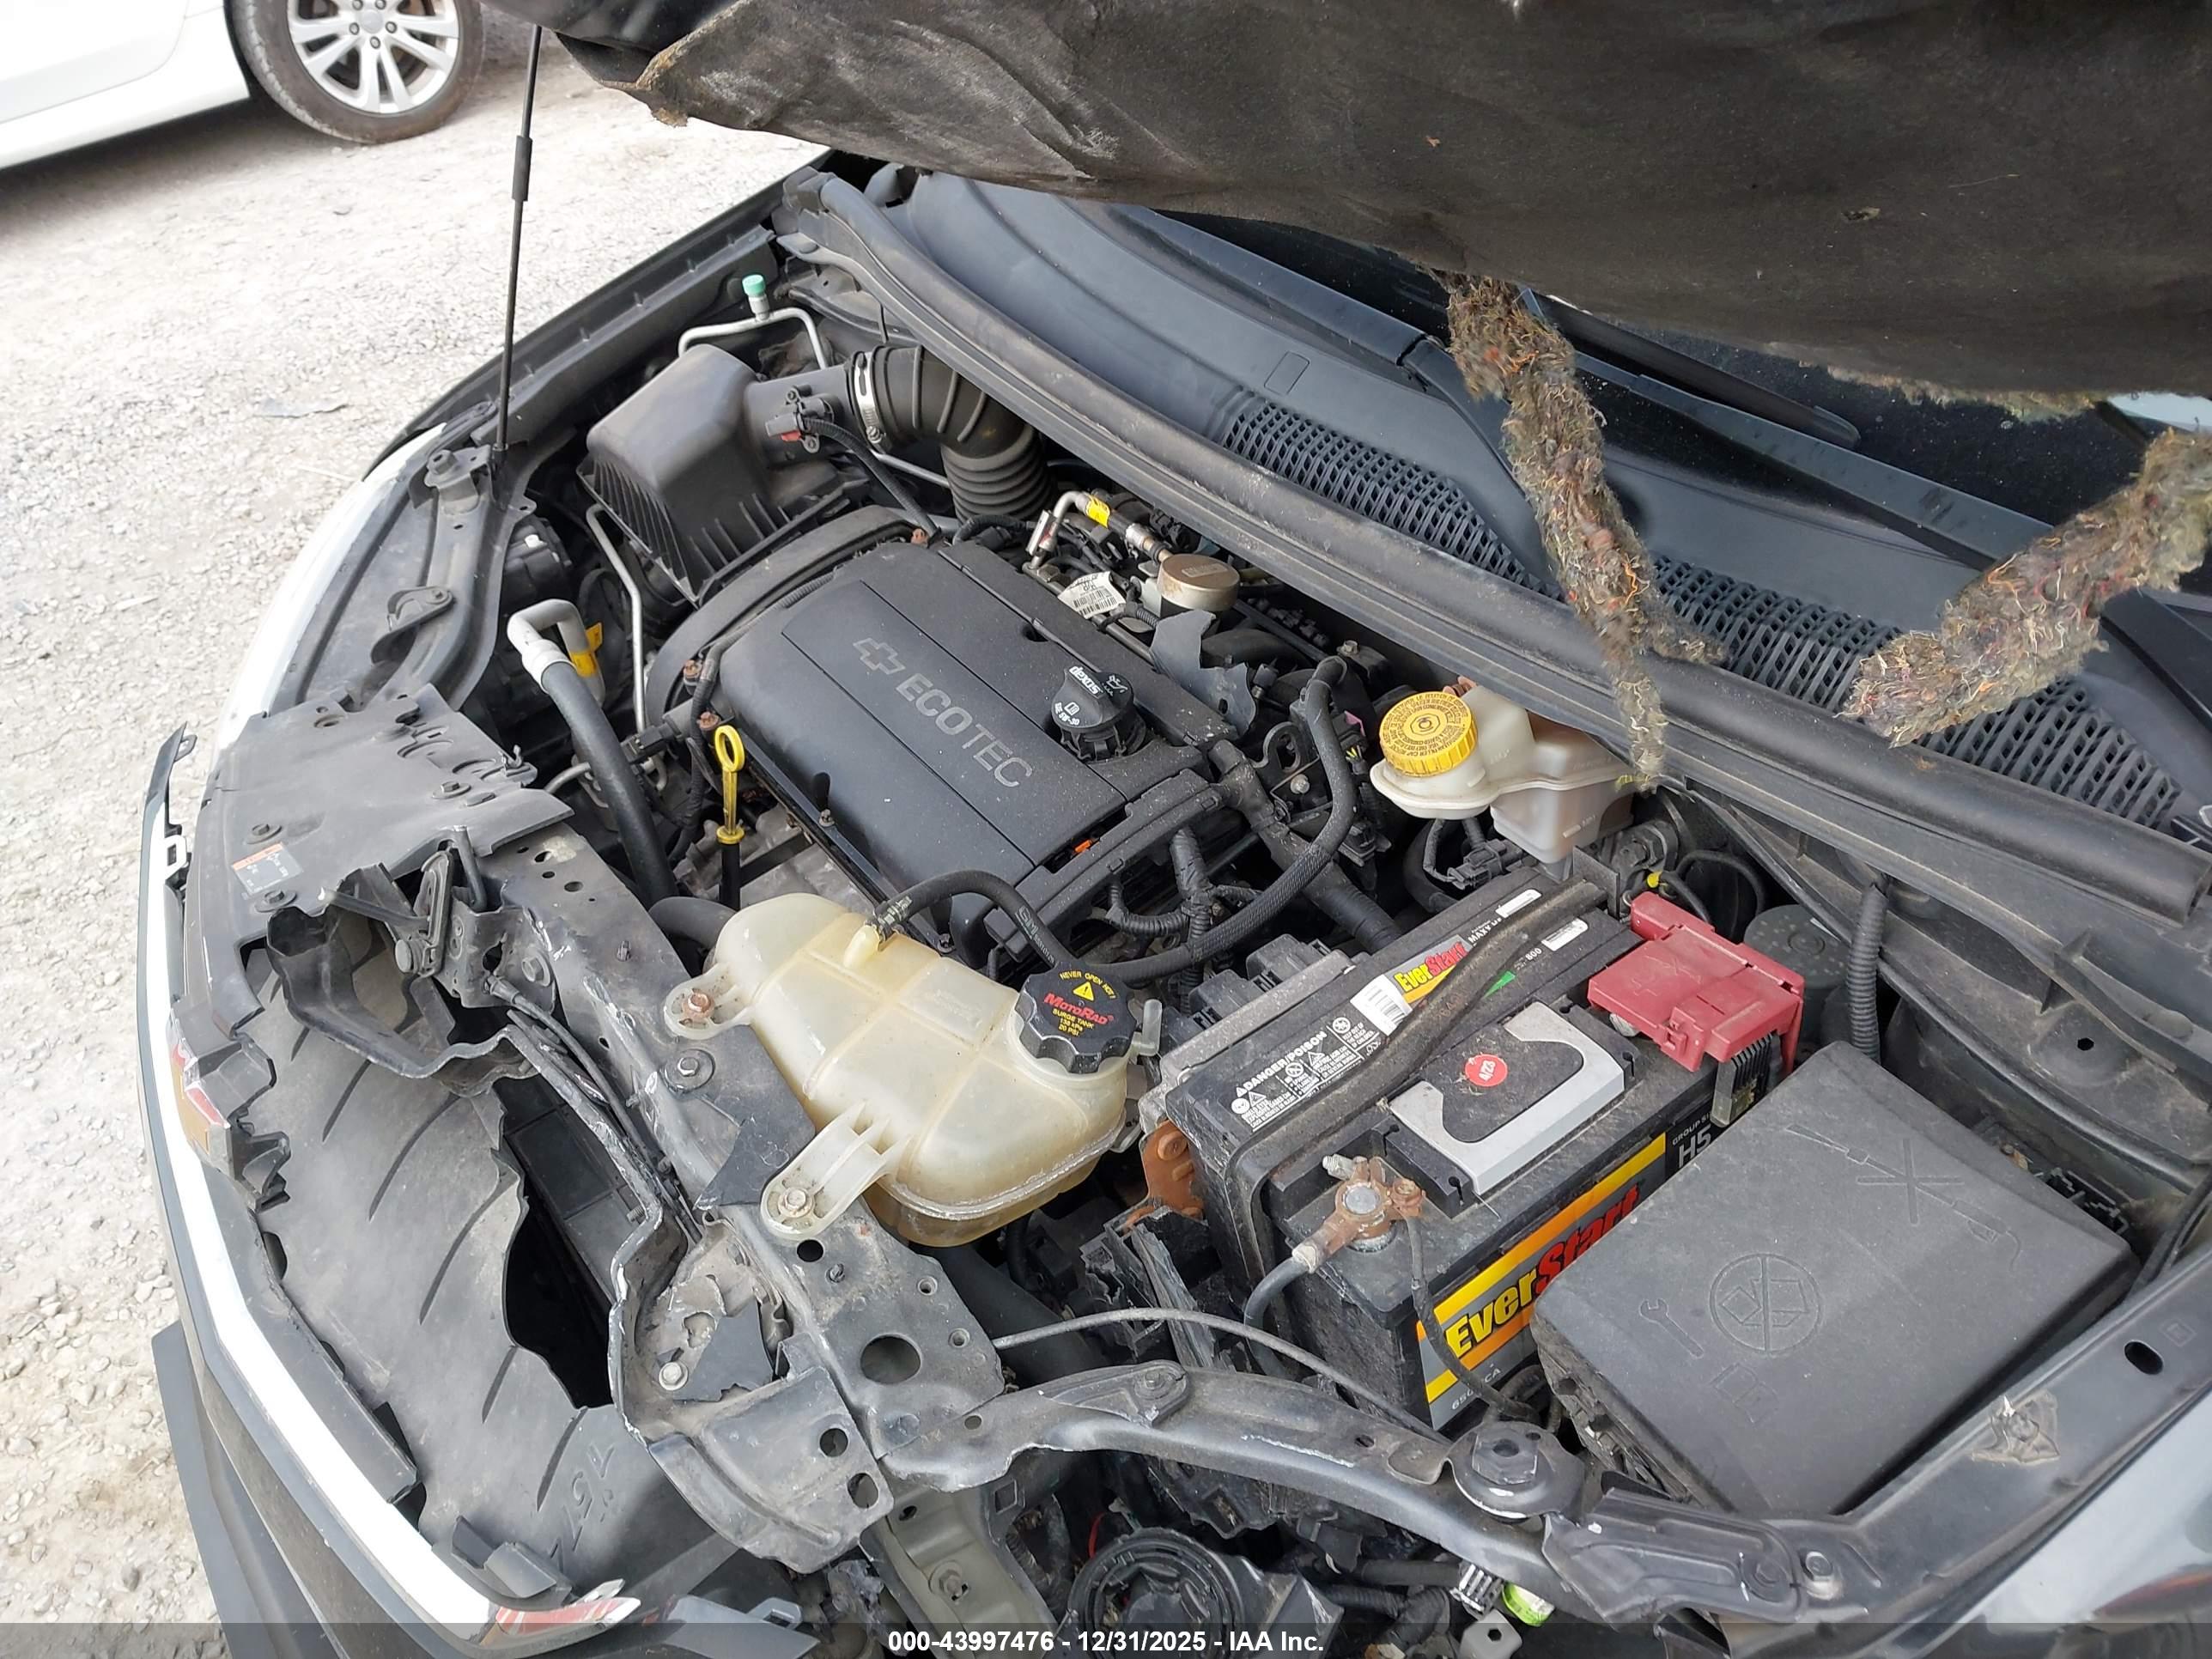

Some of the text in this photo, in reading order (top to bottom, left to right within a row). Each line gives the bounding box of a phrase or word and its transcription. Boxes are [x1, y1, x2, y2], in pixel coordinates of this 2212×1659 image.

[896, 672, 1033, 787] ECOTEC
[1395, 941, 1468, 992] EverStart
[1526, 947, 1542, 961] 800
[1059, 970, 1082, 981] NEVER
[1085, 973, 1103, 986] OPEN
[1053, 1008, 1095, 1030] SURGE TANK
[1067, 1028, 1080, 1036] PSI
[1243, 1030, 1328, 1091] DANGER/POISON
[1673, 1114, 1712, 1146] GROUP SI
[1678, 1129, 1711, 1167] H5
[1445, 1182, 1639, 1358] EverStart
